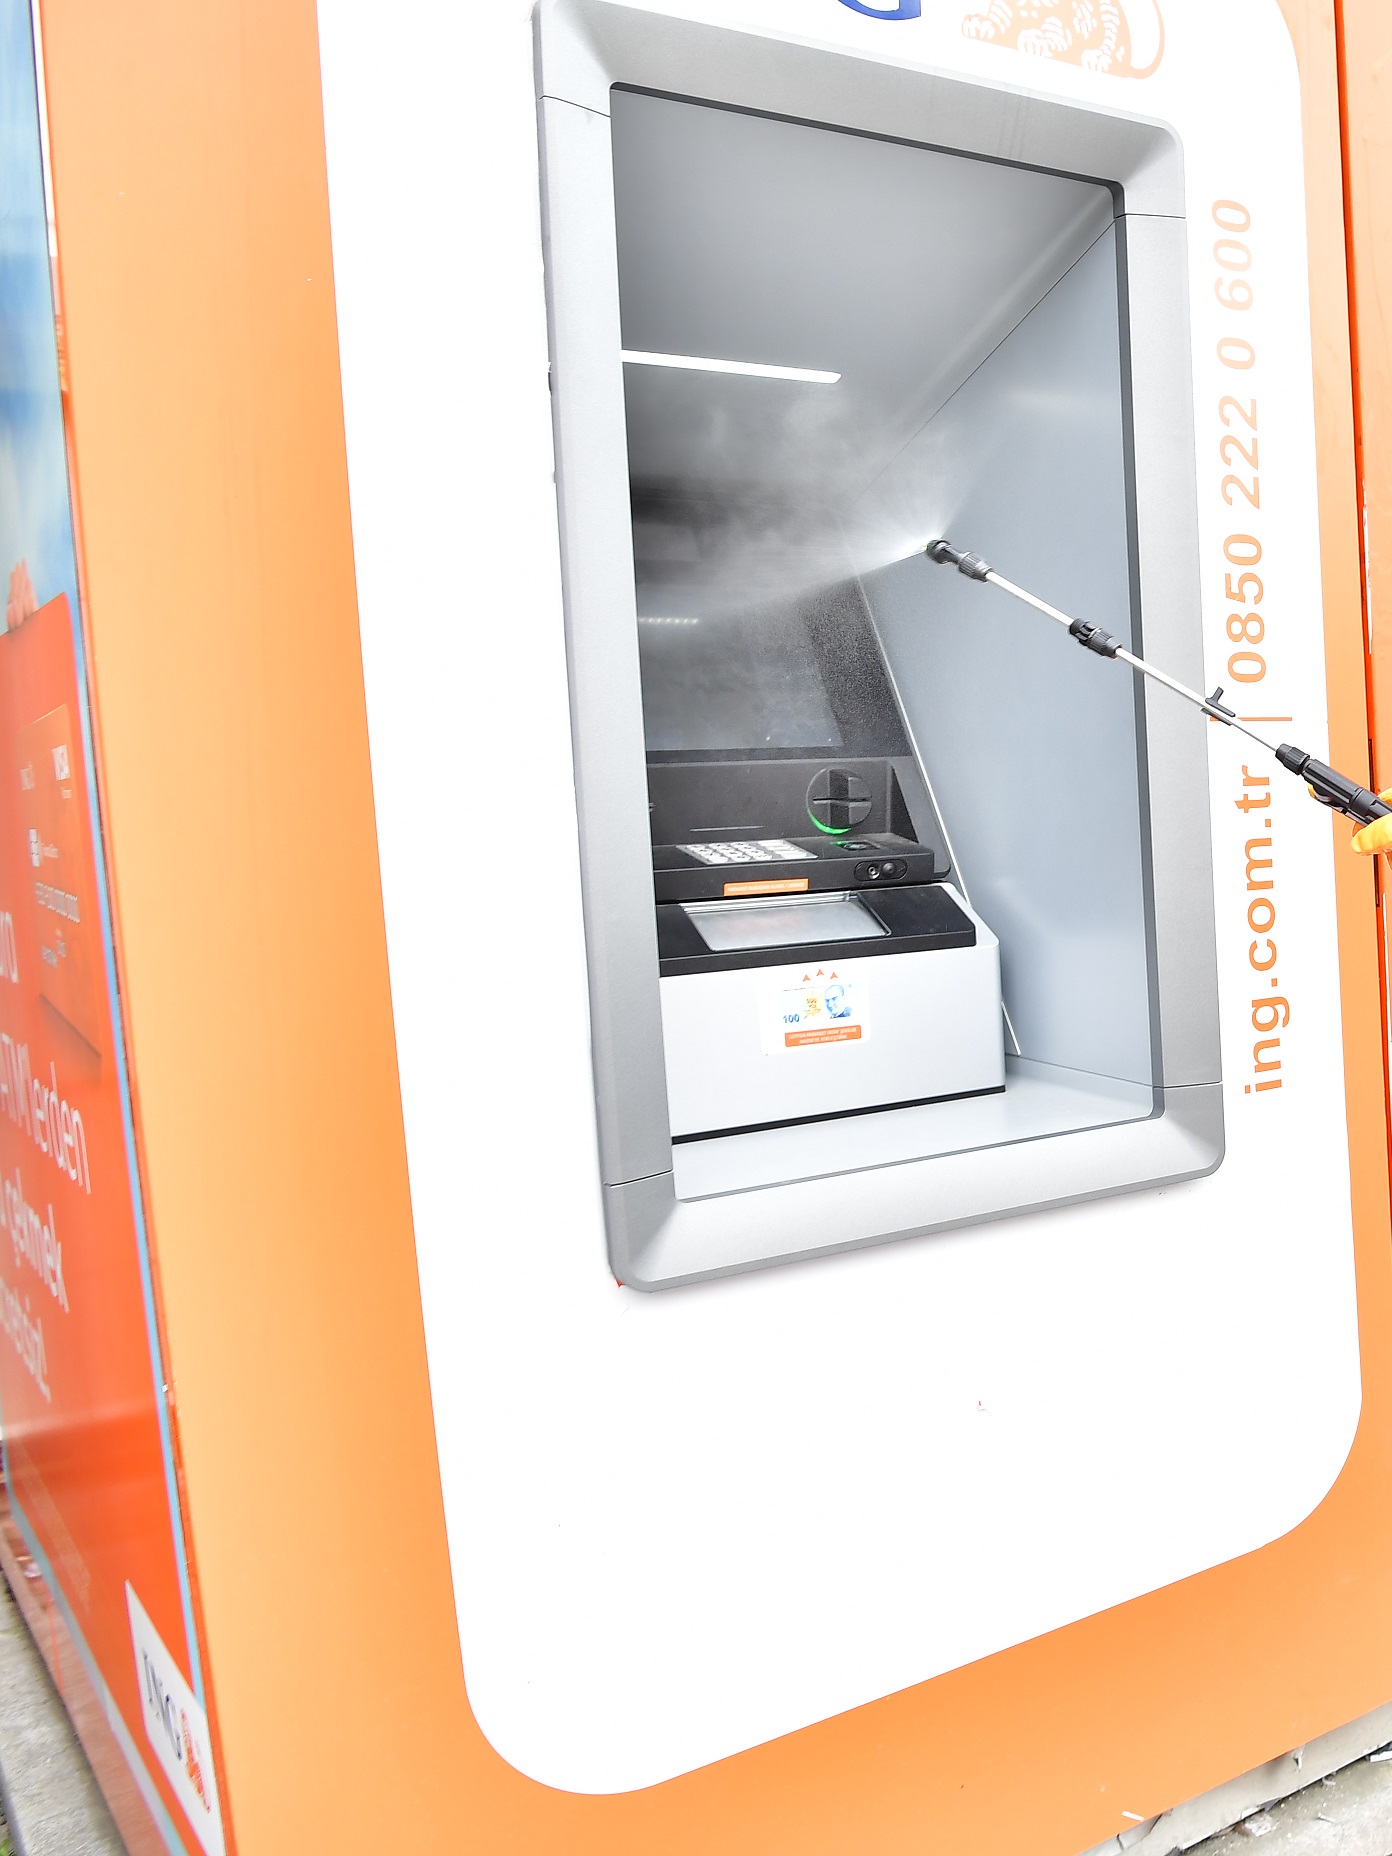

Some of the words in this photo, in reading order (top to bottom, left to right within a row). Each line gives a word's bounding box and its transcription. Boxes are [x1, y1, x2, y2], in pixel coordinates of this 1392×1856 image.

[1211, 198, 1254, 312] 600
[1216, 336, 1256, 371] 0
[1218, 395, 1260, 510] 222
[1222, 533, 1267, 683] 0850
[1234, 764, 1290, 1095] ing.com.tr
[782, 1013, 800, 1024] 100
